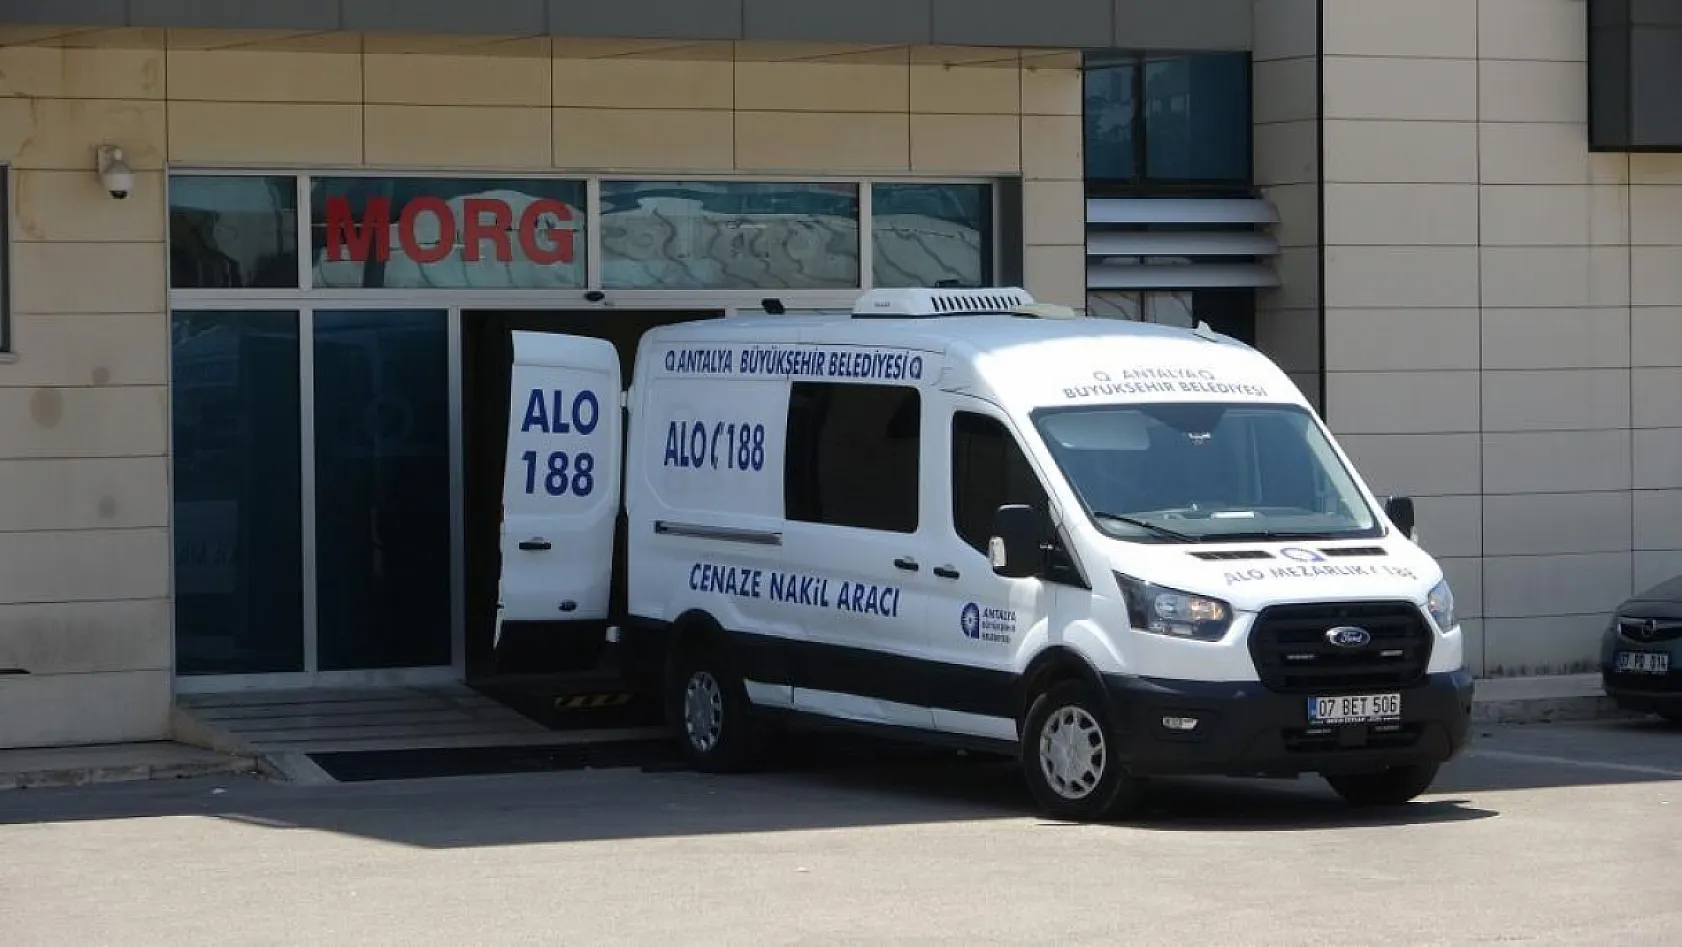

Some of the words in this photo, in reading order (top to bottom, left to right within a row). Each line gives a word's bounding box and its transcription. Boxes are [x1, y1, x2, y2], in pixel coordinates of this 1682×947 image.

[325, 195, 574, 265] MORG
[678, 349, 733, 373] ANTALYA
[1123, 367, 1194, 380] ANTALYA
[521, 388, 599, 436] ALO
[664, 420, 707, 469] ALO
[727, 423, 765, 471] 188
[521, 450, 595, 497] 188
[689, 563, 762, 599] CENAZE
[837, 581, 900, 617] ARACI
[1224, 567, 1265, 586] ALO
[1269, 565, 1369, 580] MEZARLIK
[1318, 699, 1336, 717] 07
[1343, 698, 1368, 715] BET
[1372, 695, 1398, 713] 506
